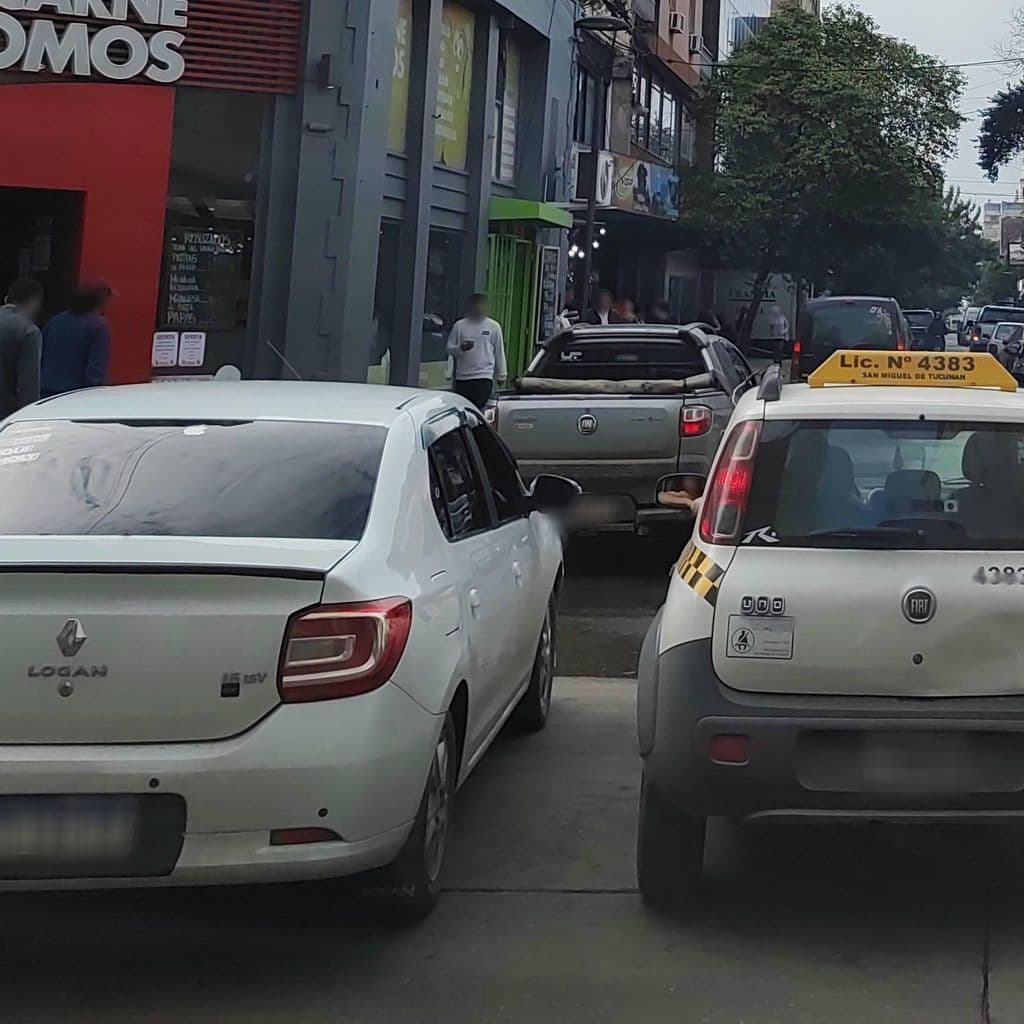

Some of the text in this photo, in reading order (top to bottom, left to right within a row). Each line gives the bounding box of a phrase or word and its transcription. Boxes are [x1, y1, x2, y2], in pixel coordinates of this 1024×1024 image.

[839, 354, 880, 369] Lic.
[917, 356, 976, 371] 4383
[862, 371, 879, 380] SAN
[881, 372, 912, 380] MIGUEL
[914, 373, 926, 381] DE
[911, 598, 929, 614] FIAT
[27, 664, 109, 678] LOGAN
